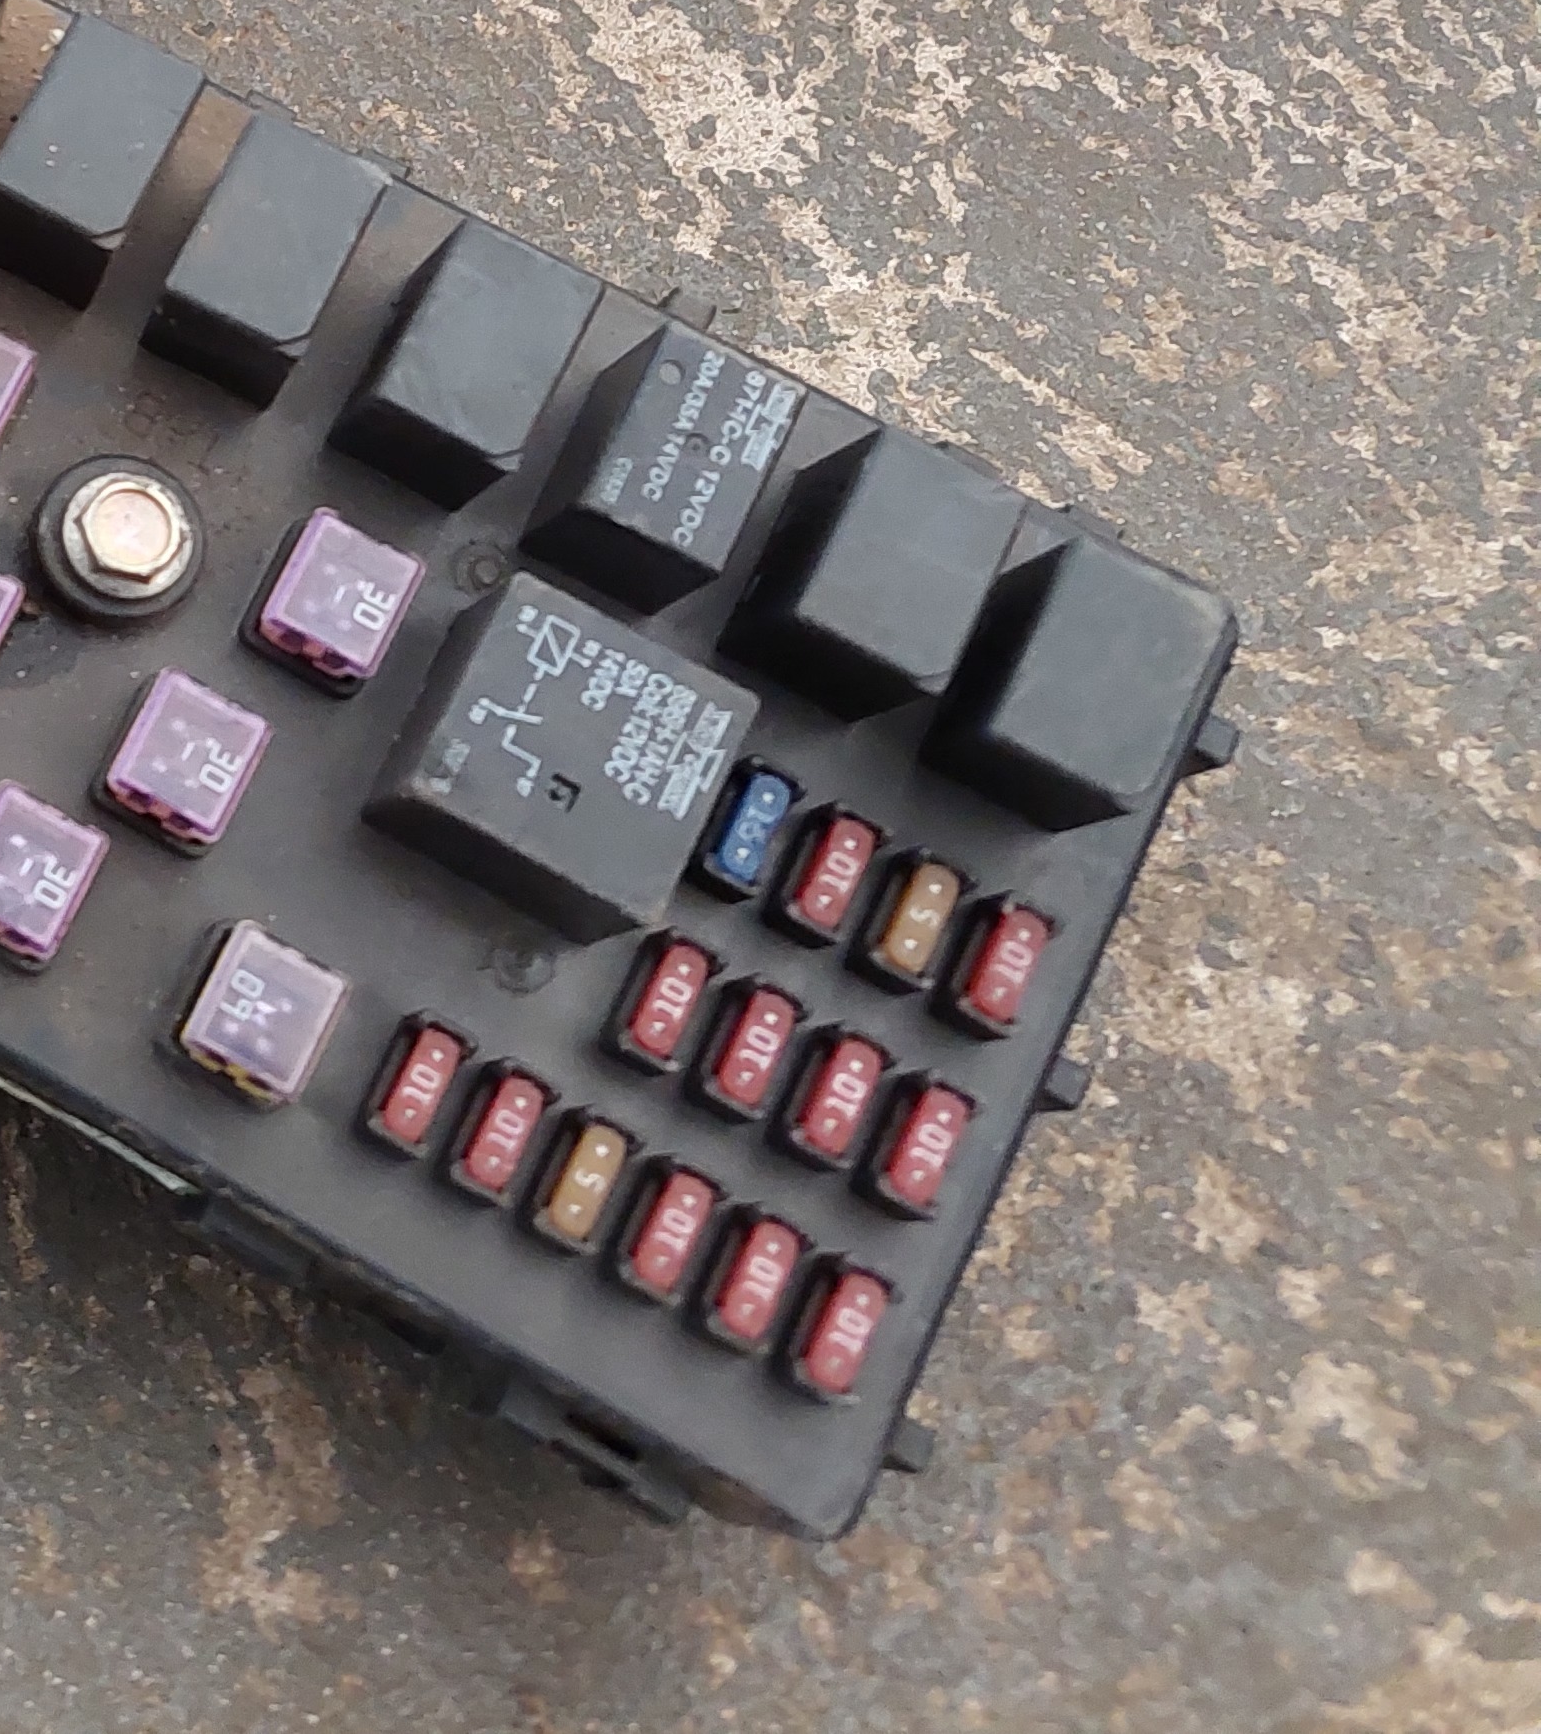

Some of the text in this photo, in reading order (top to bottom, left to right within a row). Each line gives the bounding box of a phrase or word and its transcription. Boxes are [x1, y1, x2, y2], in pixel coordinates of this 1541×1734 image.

[673, 471, 720, 546] 12VDC
[351, 580, 398, 632] 30
[198, 737, 245, 795] 30
[31, 855, 77, 911] 30
[819, 851, 861, 894] 10
[993, 940, 1034, 984] 10
[651, 976, 694, 1021] 10
[739, 1027, 780, 1070] 10
[401, 1065, 442, 1104] 10
[826, 1072, 867, 1117] 10
[487, 1107, 527, 1152] 10
[907, 1122, 952, 1167] 10
[574, 1168, 607, 1193] 5
[656, 1212, 698, 1255] 10
[741, 1258, 782, 1301] 10
[827, 1305, 872, 1351] 10
